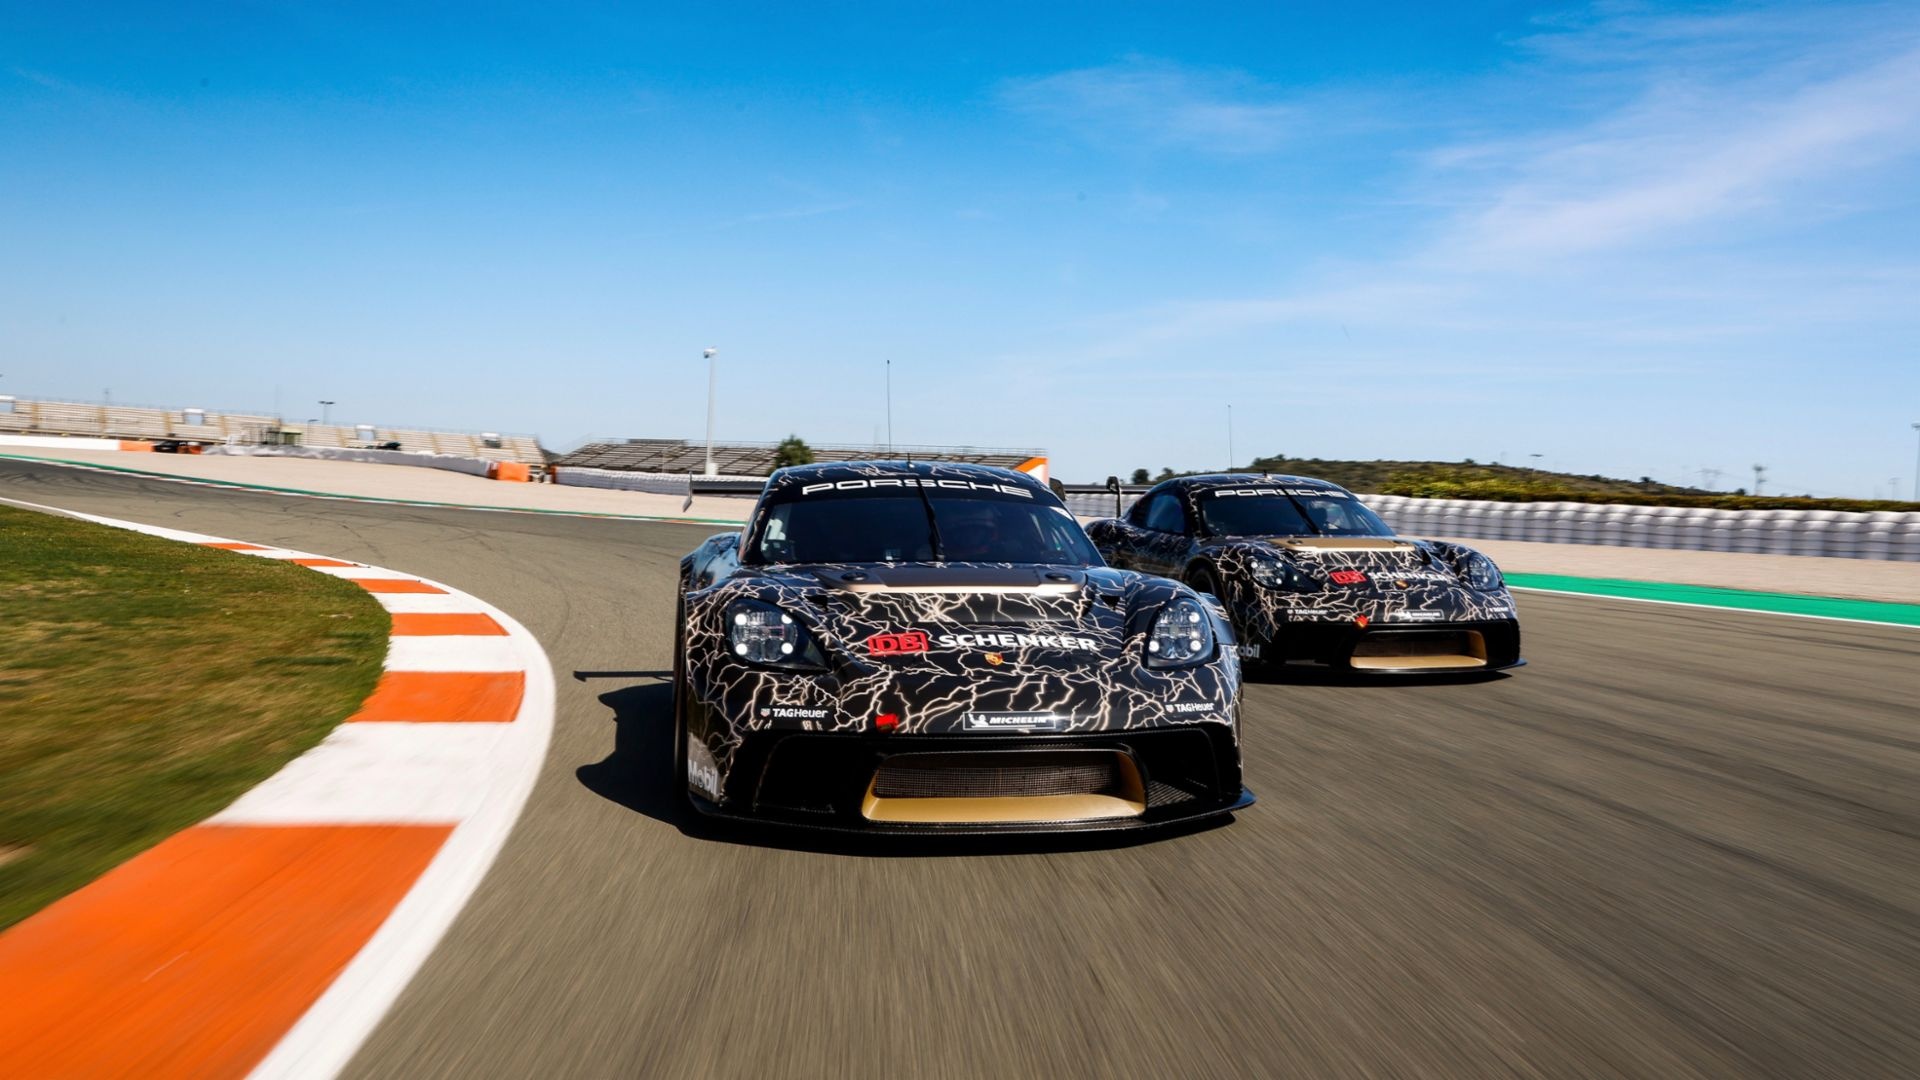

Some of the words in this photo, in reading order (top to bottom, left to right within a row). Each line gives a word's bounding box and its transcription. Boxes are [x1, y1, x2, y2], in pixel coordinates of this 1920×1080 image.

[802, 478, 1034, 499] PORSCHE
[1214, 488, 1349, 498] PORSCHE
[876, 635, 923, 652] DB
[938, 634, 1098, 650] SCHENKER
[1238, 643, 1260, 660] obil
[989, 716, 1047, 724] MICHELIN
[688, 760, 718, 795] Mobil
